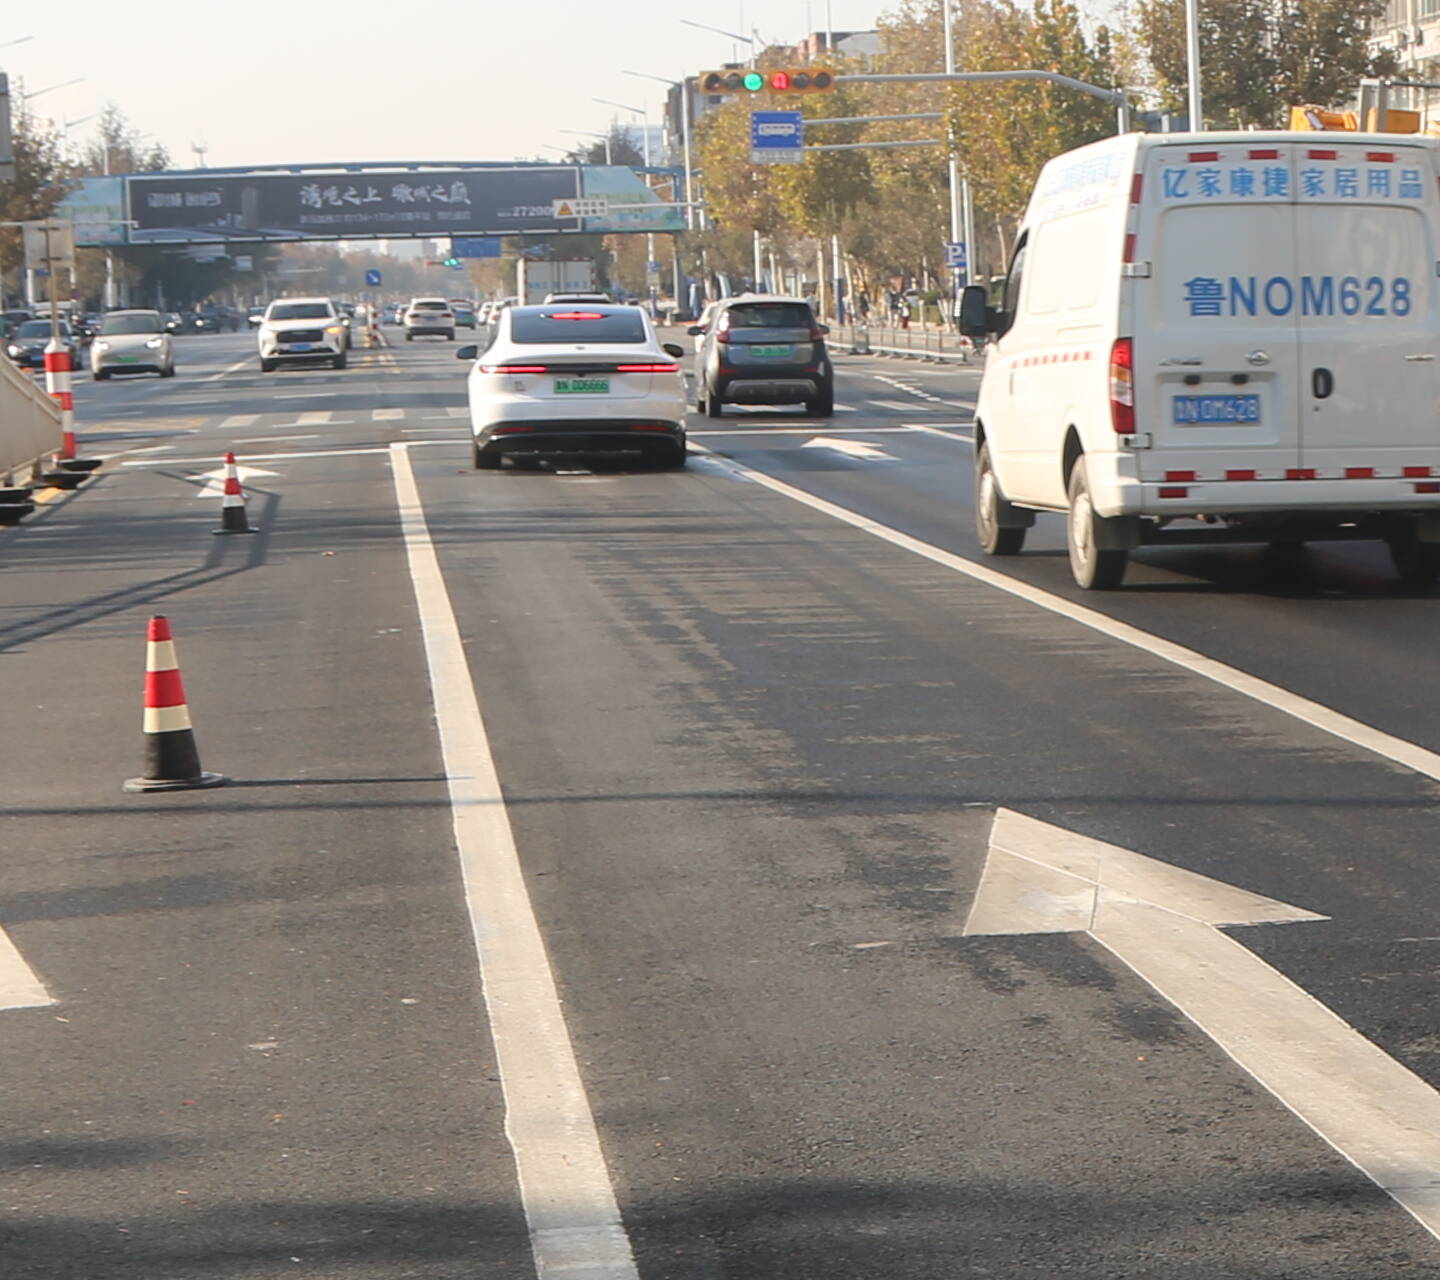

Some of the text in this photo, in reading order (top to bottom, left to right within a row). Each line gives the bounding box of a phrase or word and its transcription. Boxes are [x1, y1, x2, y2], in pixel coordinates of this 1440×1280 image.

[1162, 167, 1423, 199] 亿家康捷家居用品
